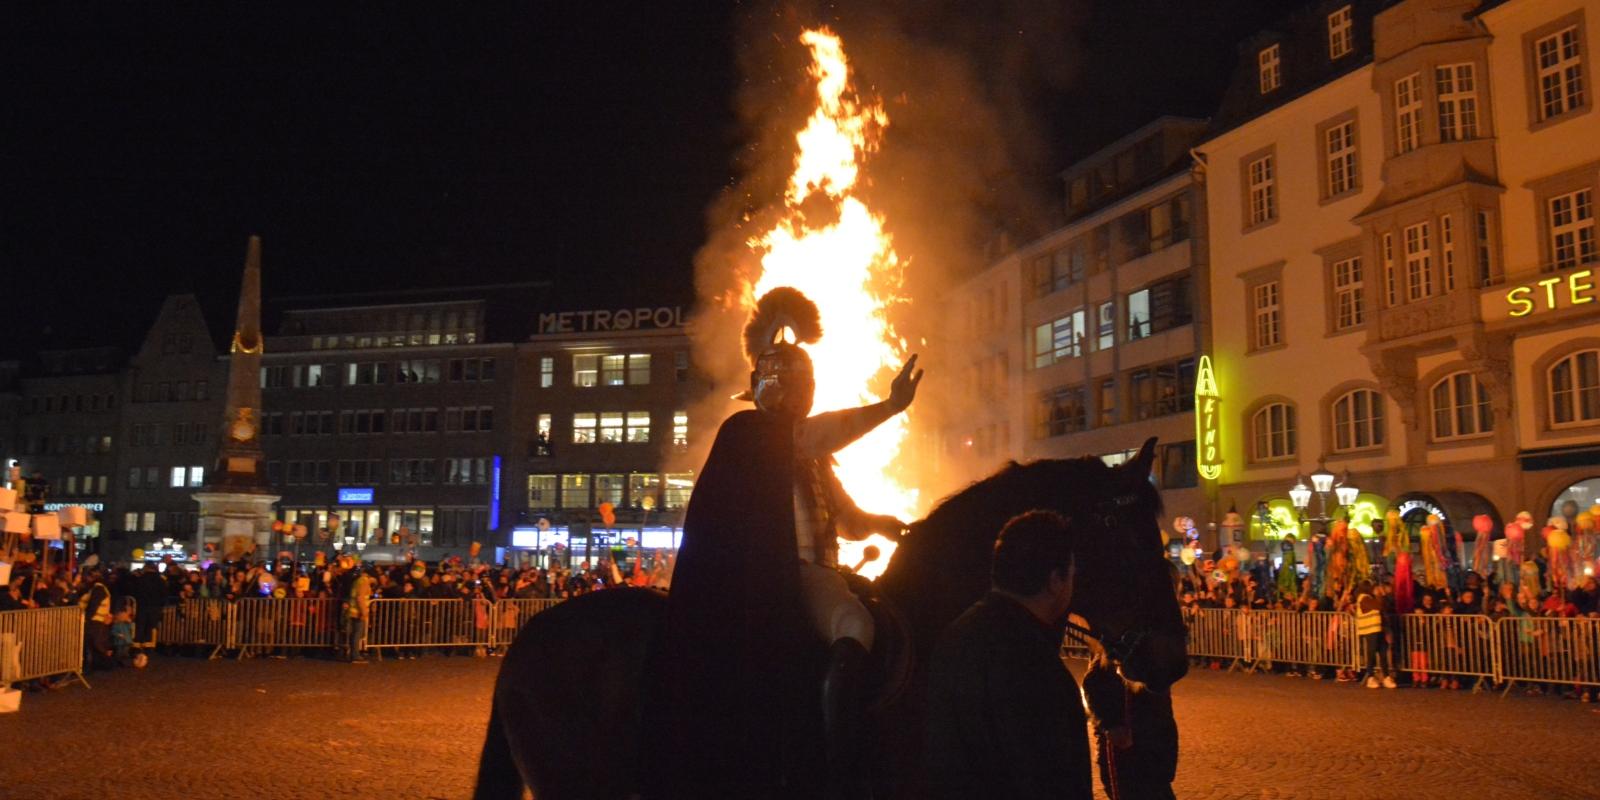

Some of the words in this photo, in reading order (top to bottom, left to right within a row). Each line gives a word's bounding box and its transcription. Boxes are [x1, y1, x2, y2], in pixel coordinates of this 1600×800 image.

[1506, 270, 1593, 316] STE
[538, 306, 692, 334] METROPOL
[1204, 398, 1216, 461] KINO
